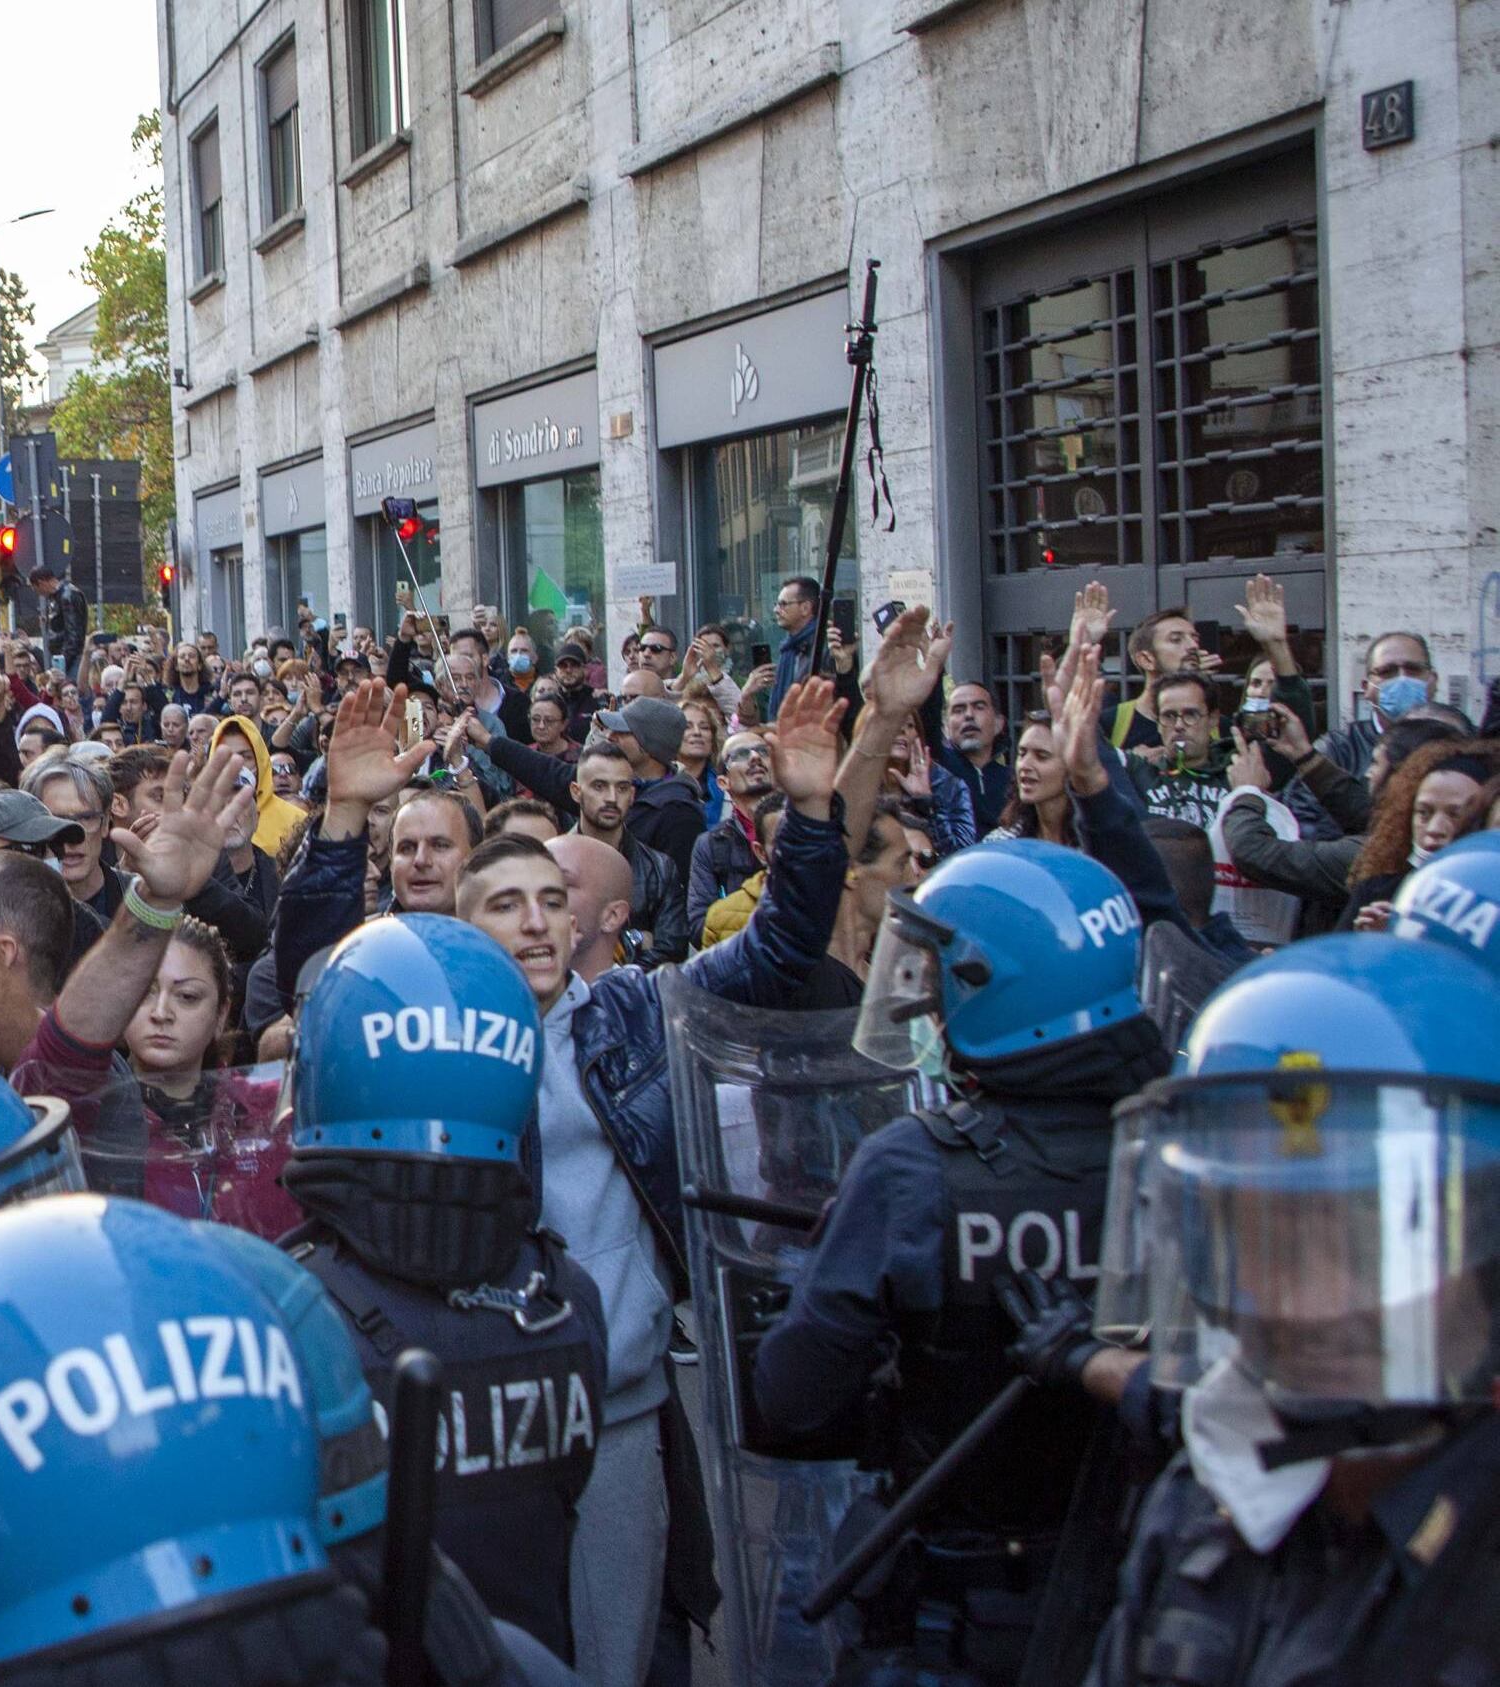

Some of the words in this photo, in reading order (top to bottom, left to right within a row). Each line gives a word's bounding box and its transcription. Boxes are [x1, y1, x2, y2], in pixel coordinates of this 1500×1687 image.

[1364, 93, 1403, 139] 48
[488, 429, 501, 465] di
[504, 416, 561, 462] Sondrio
[356, 471, 383, 498] Banca
[386, 454, 433, 495] Popolare
[361, 1005, 536, 1075] POLIZIA
